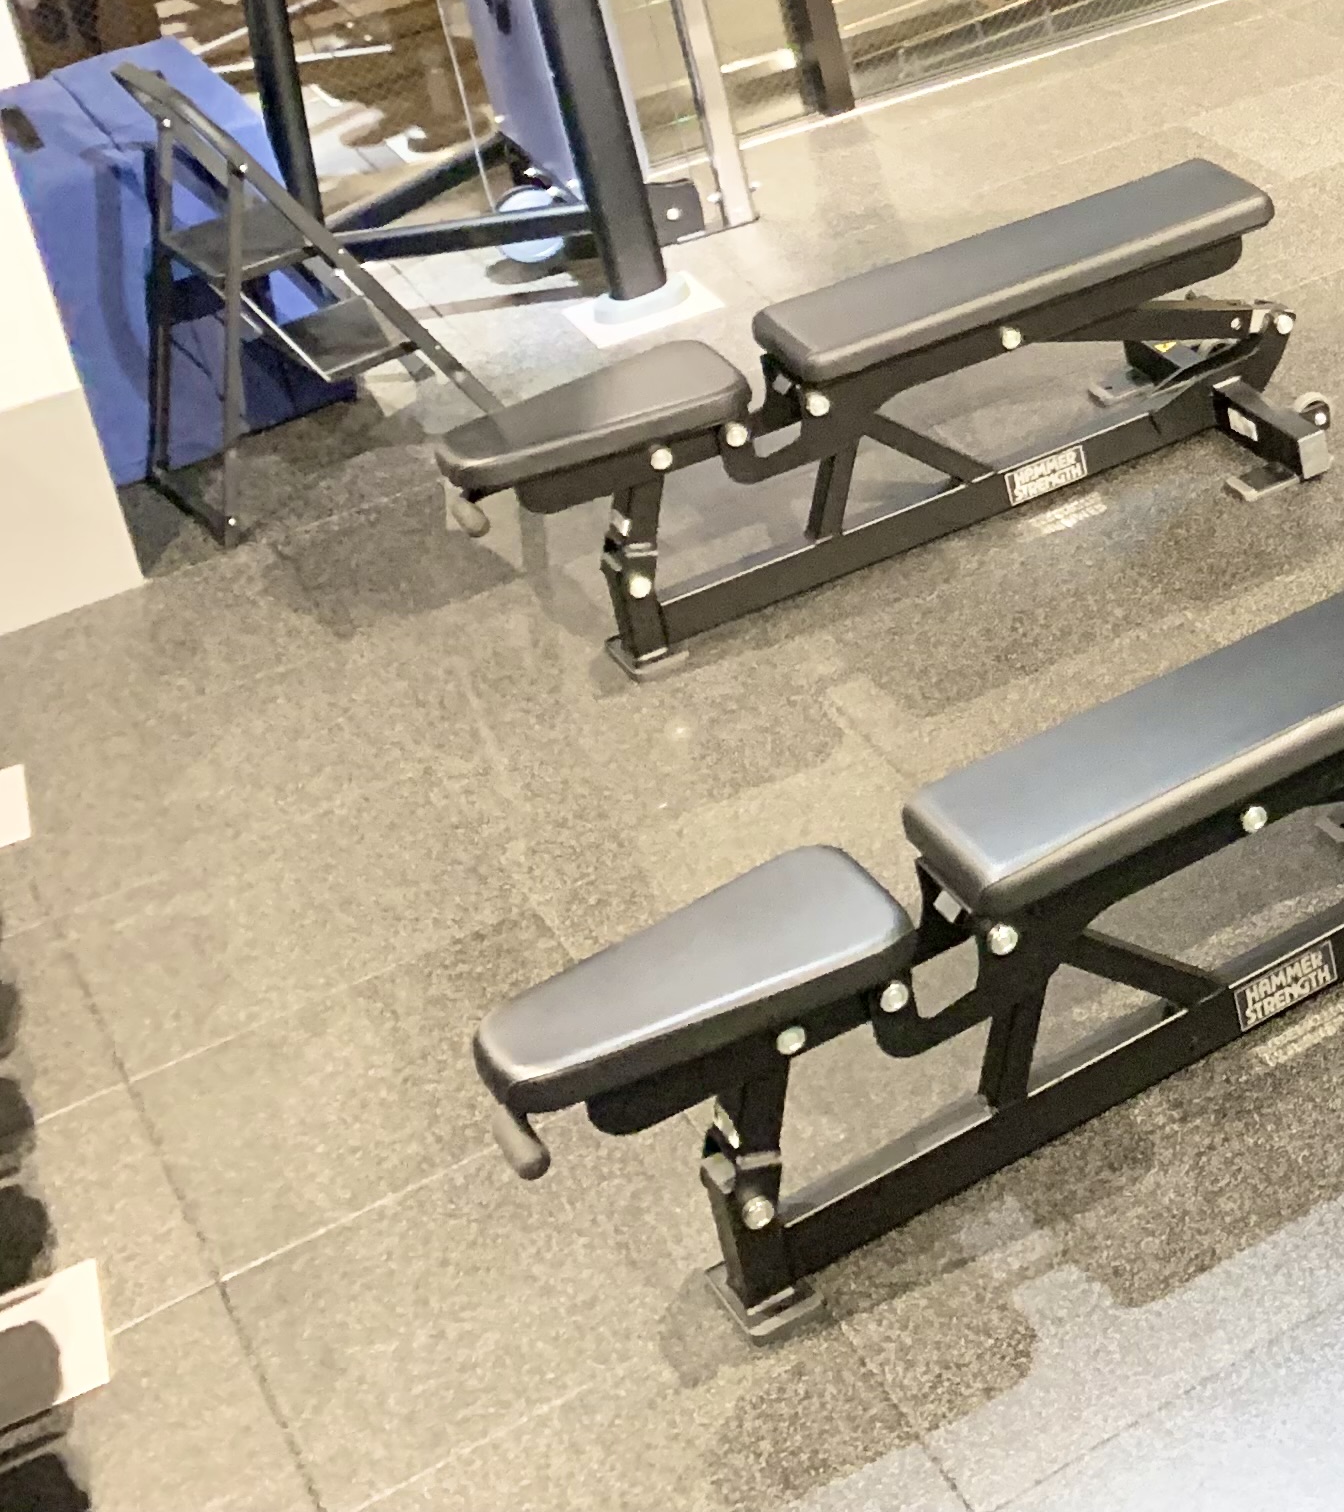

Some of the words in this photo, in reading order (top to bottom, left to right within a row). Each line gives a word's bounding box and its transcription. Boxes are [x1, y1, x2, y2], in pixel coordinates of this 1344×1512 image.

[1012, 450, 1077, 488] HAMMER
[1013, 462, 1083, 502] STRENGTH
[1244, 950, 1323, 1009] HAMMER
[1245, 964, 1332, 1026] STRENGTH
